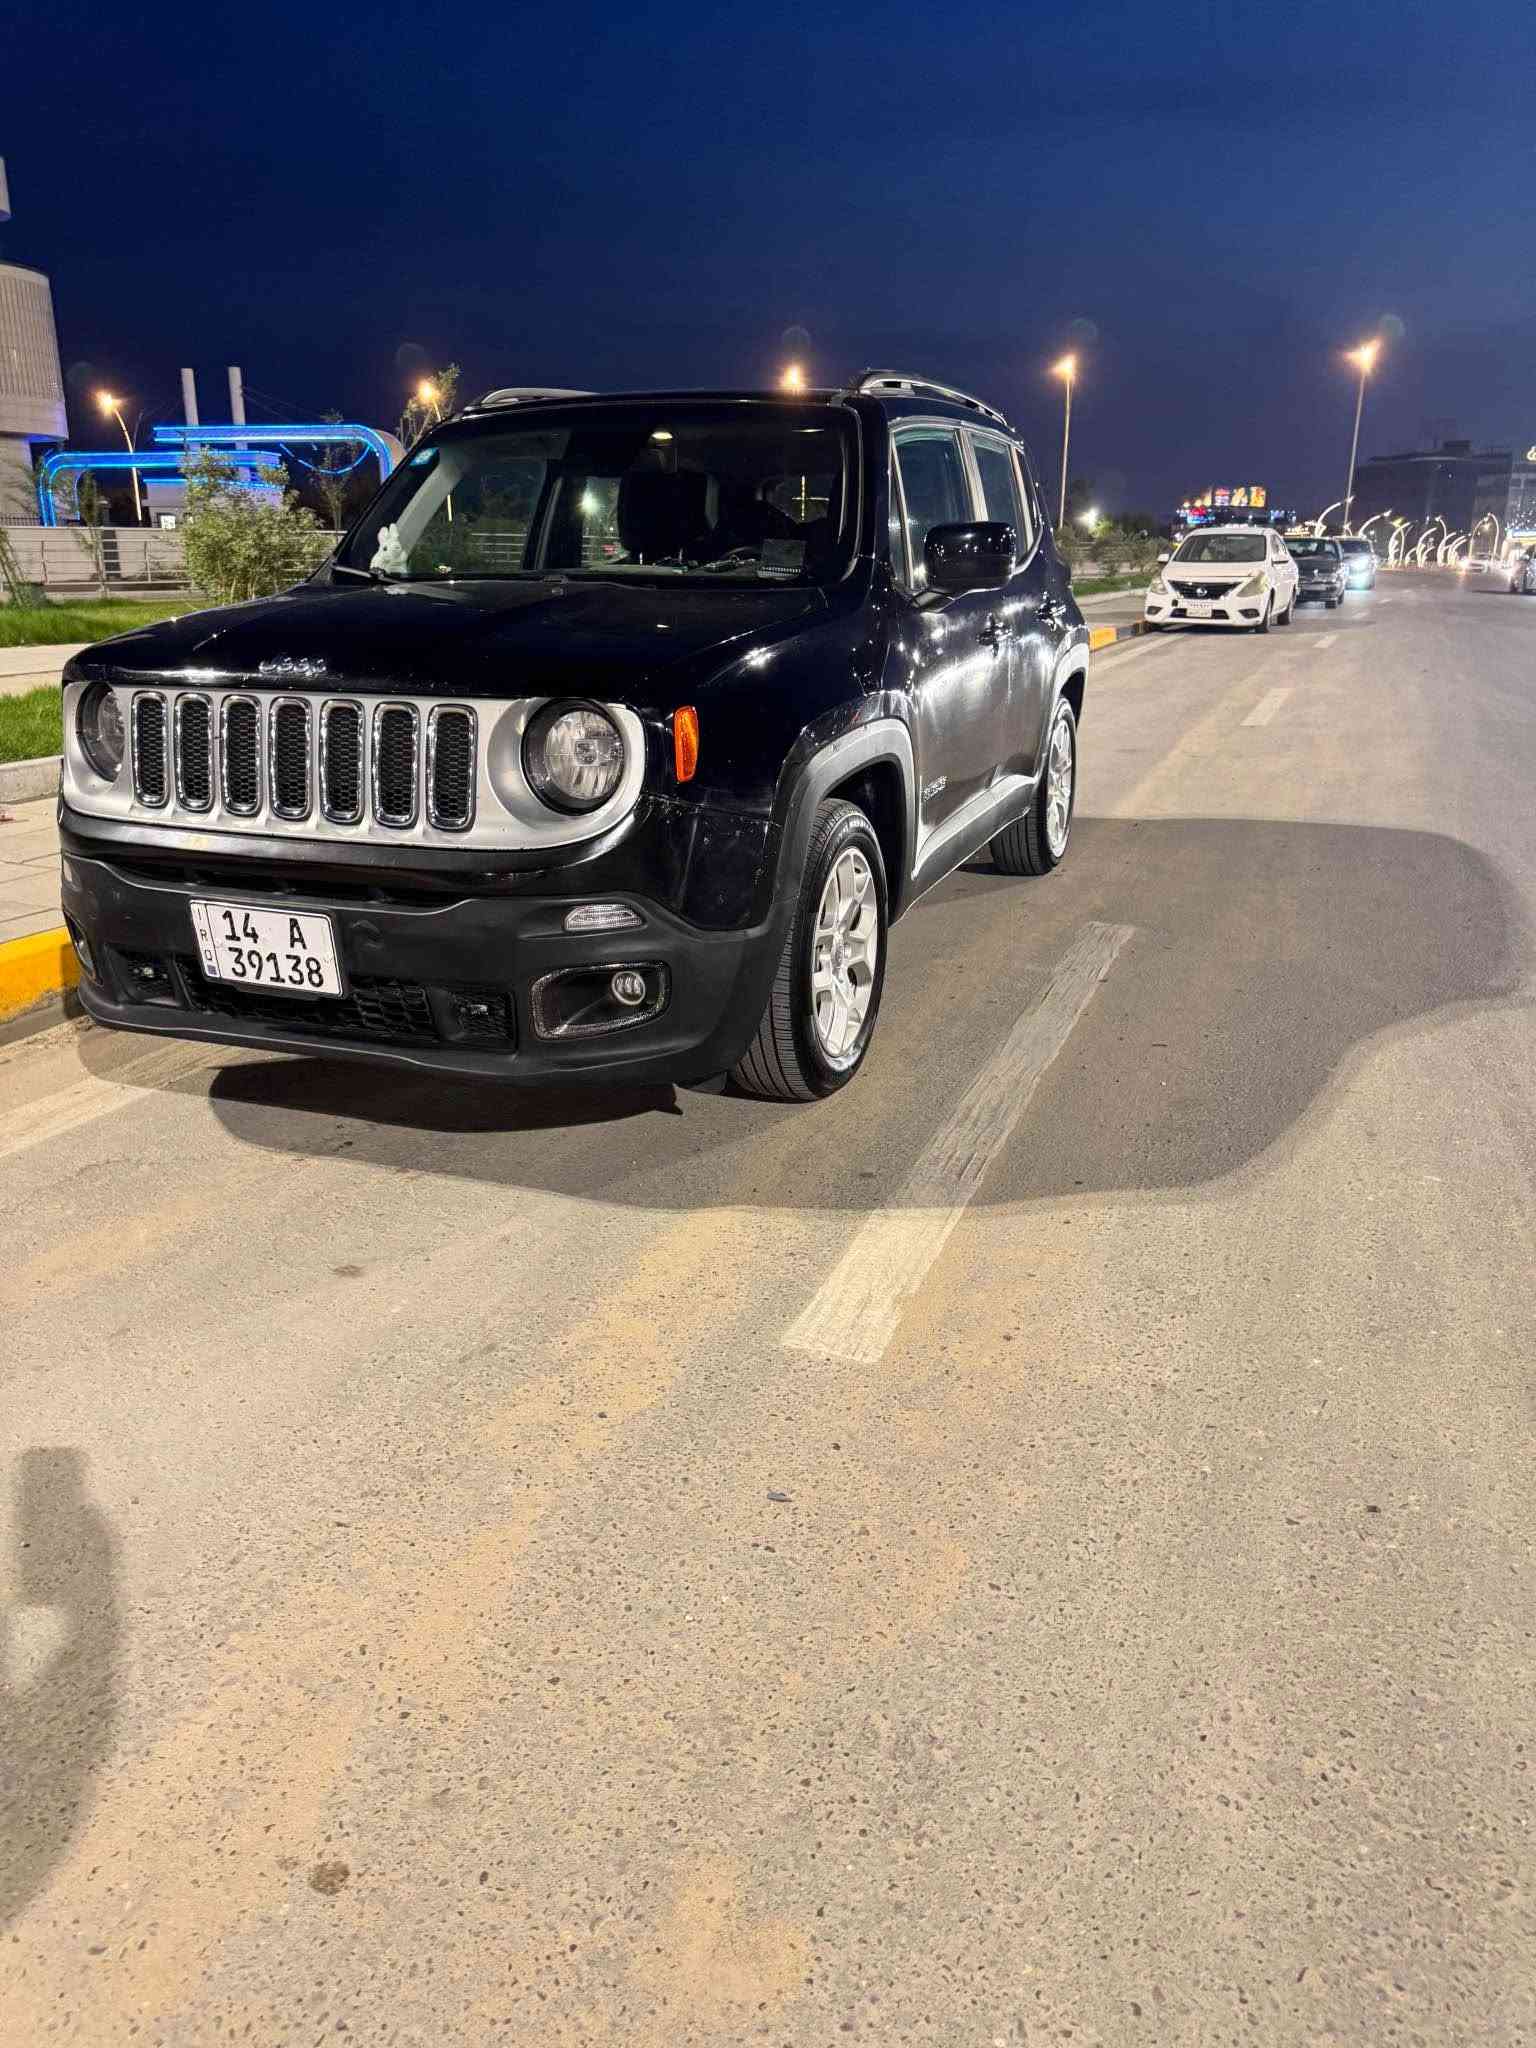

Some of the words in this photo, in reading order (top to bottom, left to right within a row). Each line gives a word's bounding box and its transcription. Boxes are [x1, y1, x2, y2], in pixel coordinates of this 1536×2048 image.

[223, 910, 259, 944] 14
[289, 918, 307, 950] A
[228, 947, 324, 987] 39138
